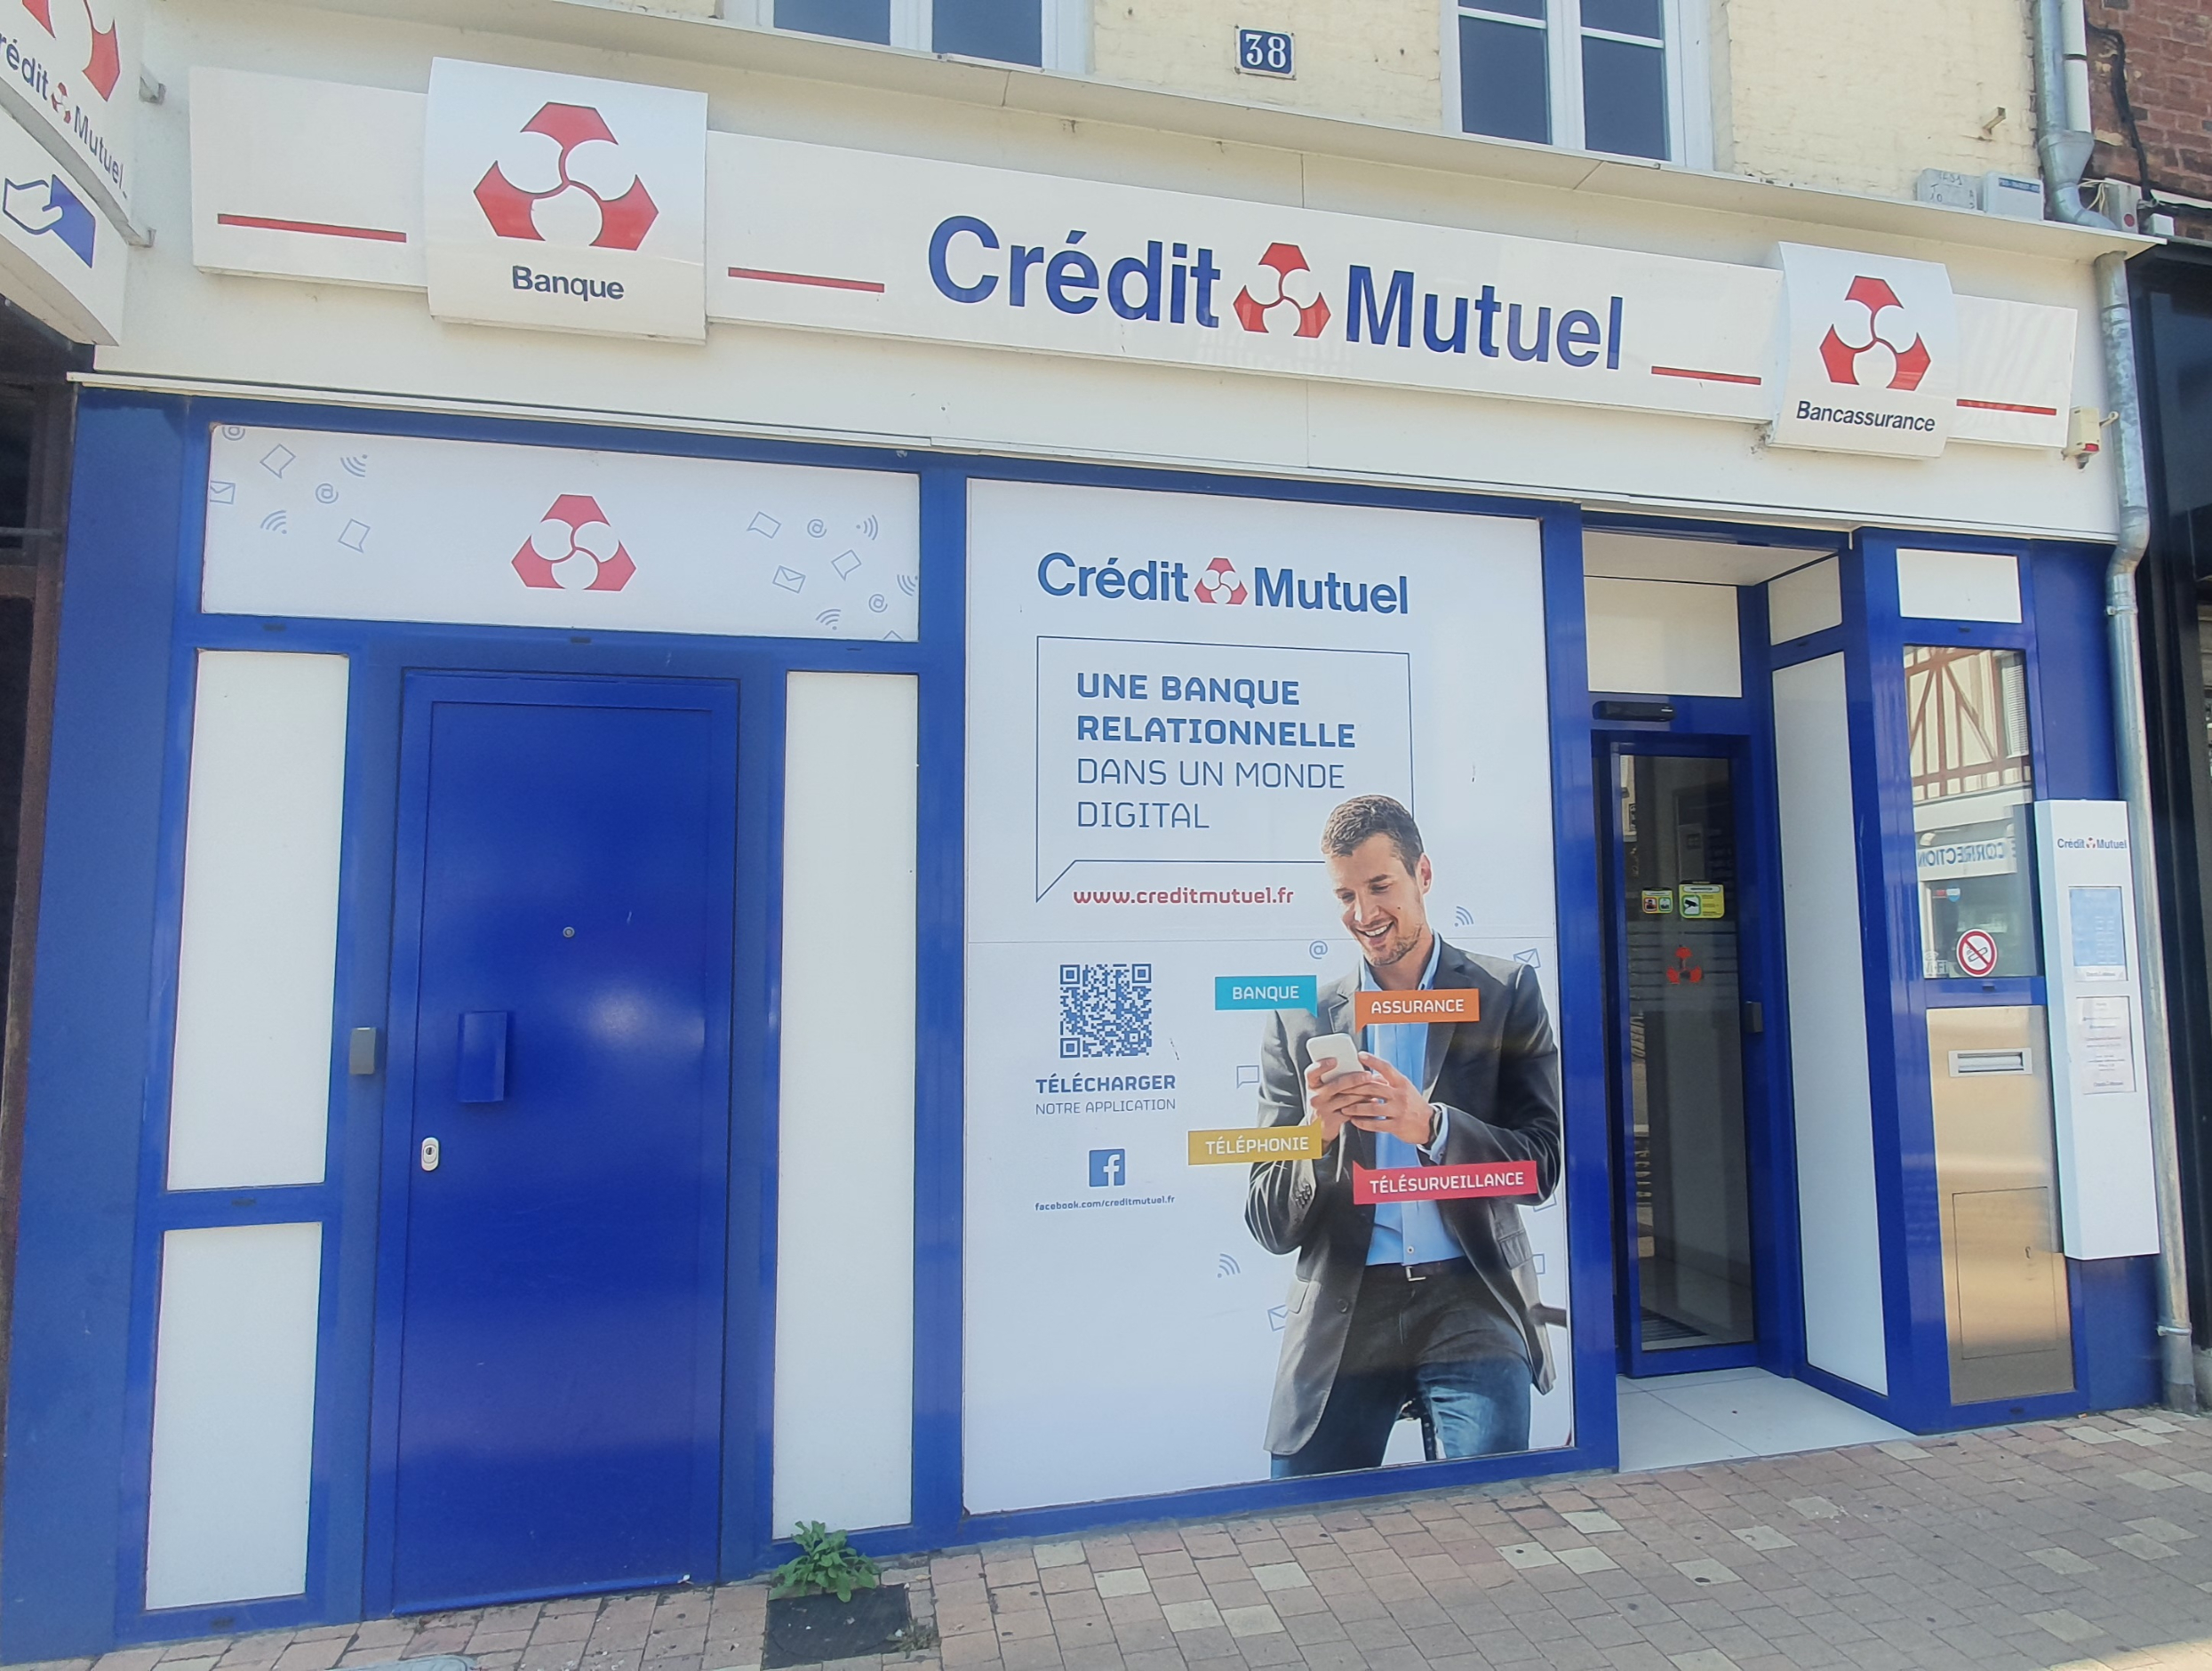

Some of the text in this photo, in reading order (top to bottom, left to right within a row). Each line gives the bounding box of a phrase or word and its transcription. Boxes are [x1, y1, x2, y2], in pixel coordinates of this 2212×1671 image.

[1245, 33, 1286, 68] 38
[0, 33, 124, 189] rédit Mutuel
[512, 265, 625, 301] Banque
[928, 215, 1624, 370] Crédit Mutuel
[1796, 400, 1936, 432] Bancassurance
[1037, 552, 1409, 614] Crédit Mutuel
[1077, 673, 1300, 708] UNE BANQUE
[1077, 716, 1356, 748] RELATIONNELLE
[1078, 758, 1346, 789] DANS UN MONDE
[1077, 801, 1210, 829] DIGITAL
[2096, 839, 2128, 849] Mutuel
[1074, 887, 1294, 905] www.creditmutuel.fr
[1233, 986, 1299, 1001] BANQUE
[1370, 999, 1465, 1014] ASSURANCE
[1035, 1072, 1176, 1094] TÉLÉCHARGER
[1035, 1099, 1176, 1115] NOTRE APPLICATION
[1205, 1135, 1309, 1155] TÉLÉPHONIE
[1370, 1171, 1524, 1194] TÉLÉSURVEILLANCE
[1035, 1195, 1175, 1211] facebook.com/creditmutuel.fr
